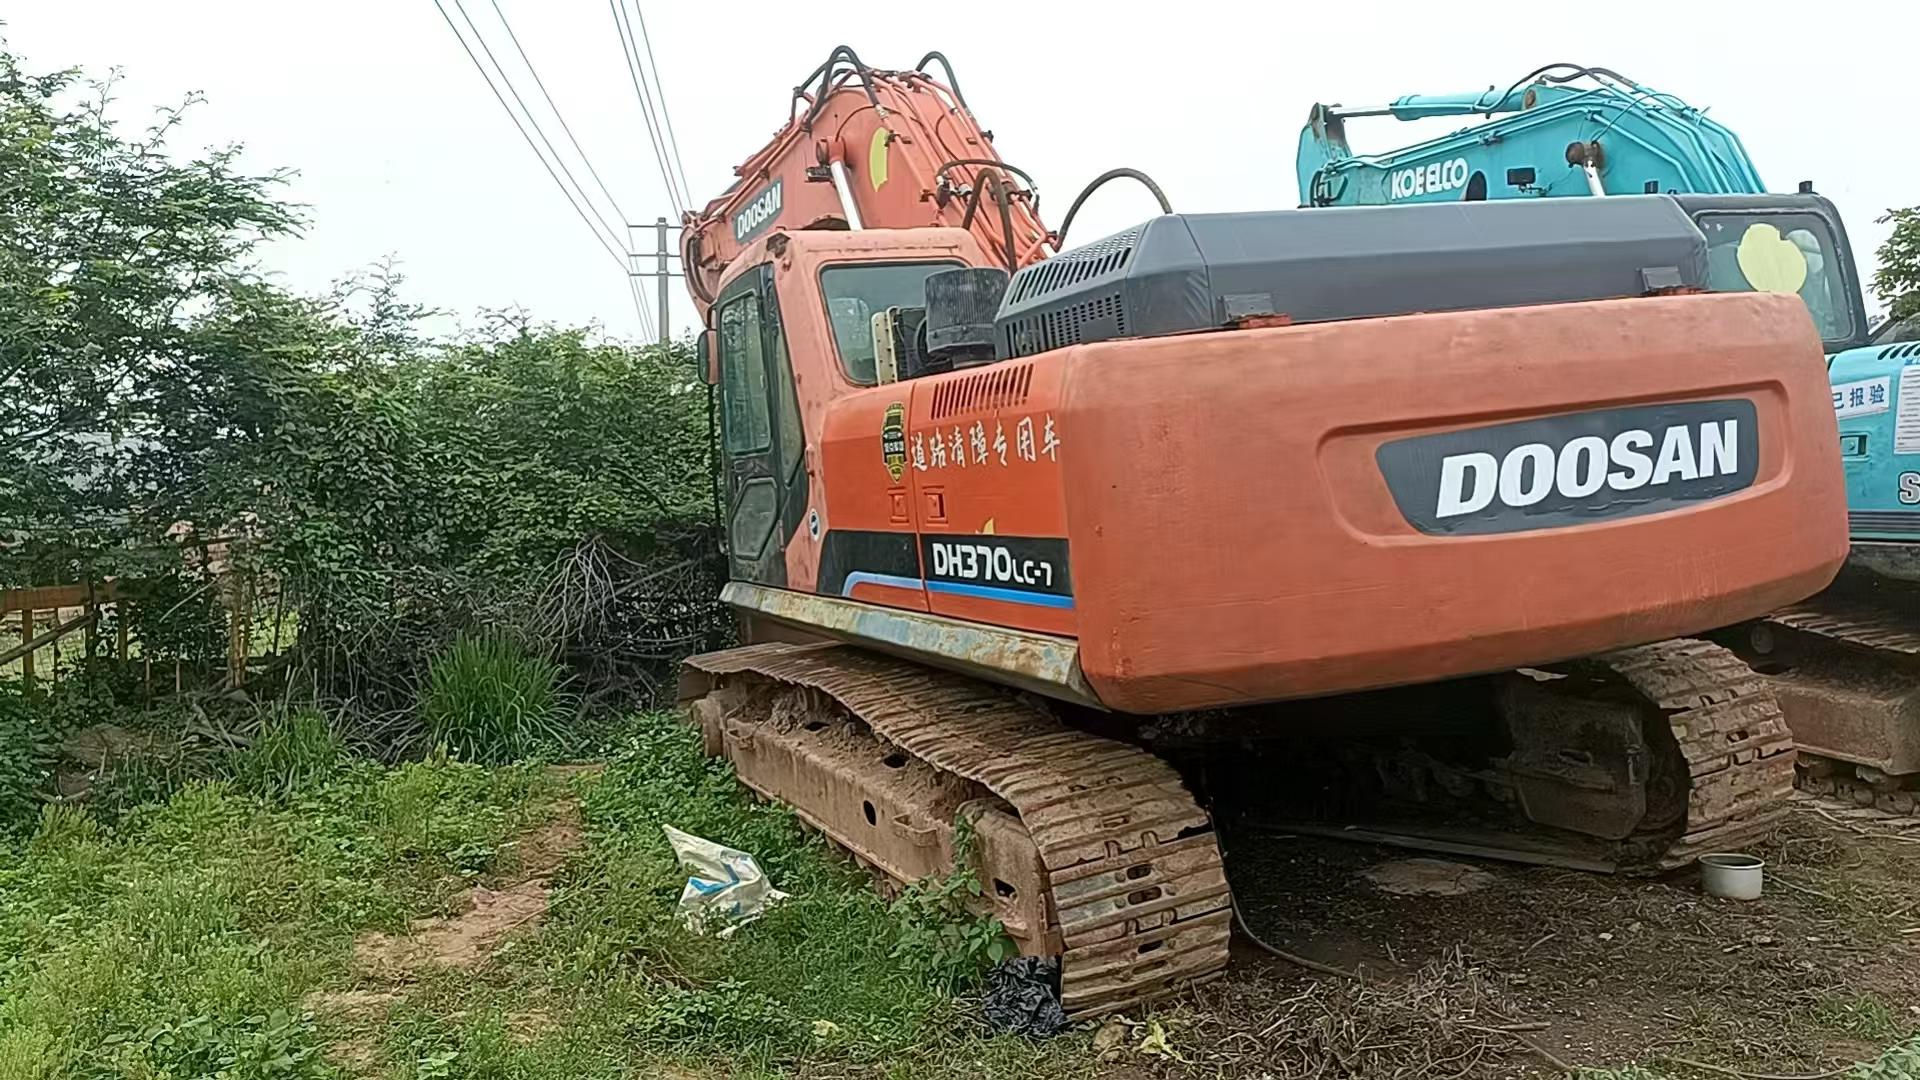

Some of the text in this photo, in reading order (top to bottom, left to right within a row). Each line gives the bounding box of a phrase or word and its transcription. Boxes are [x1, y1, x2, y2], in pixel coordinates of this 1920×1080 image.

[737, 182, 781, 239] DOOSAN
[910, 413, 1061, 472] 道路清障专用车
[1435, 419, 1738, 519] DOOSAN
